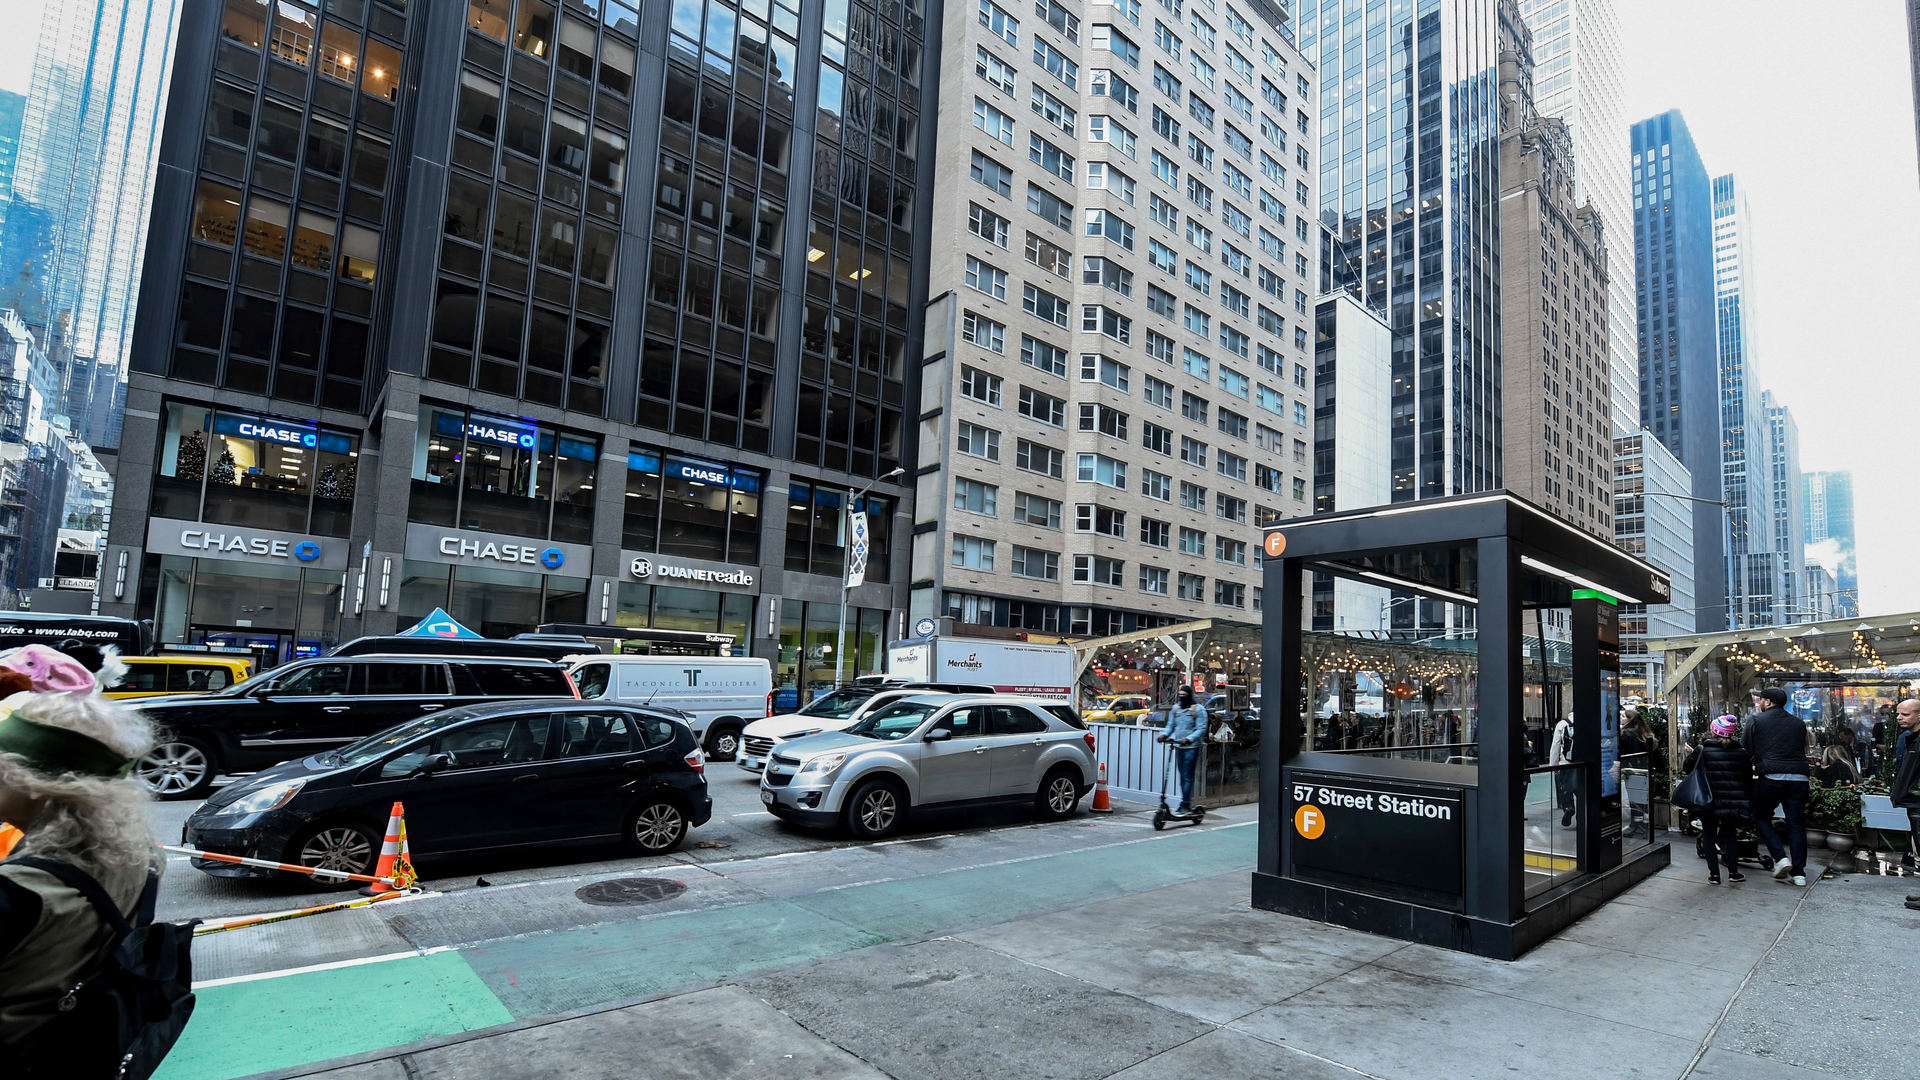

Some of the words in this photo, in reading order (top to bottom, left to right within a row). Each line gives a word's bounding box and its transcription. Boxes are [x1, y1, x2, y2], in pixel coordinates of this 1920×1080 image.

[239, 423, 301, 443] CHASE
[461, 424, 519, 444] CHASE
[681, 467, 725, 484] CHASE
[180, 530, 290, 557] CHASE
[440, 536, 538, 564] CHASE
[1271, 537, 1280, 551] F
[1650, 573, 1670, 601] Subway
[34, 627, 119, 639] www.labq.com
[705, 634, 735, 644] Subway
[947, 659, 983, 669] Merchants
[1293, 785, 1314, 802] 57
[1318, 787, 1374, 811] Street
[1378, 794, 1451, 820] Station
[1303, 810, 1318, 832] F
